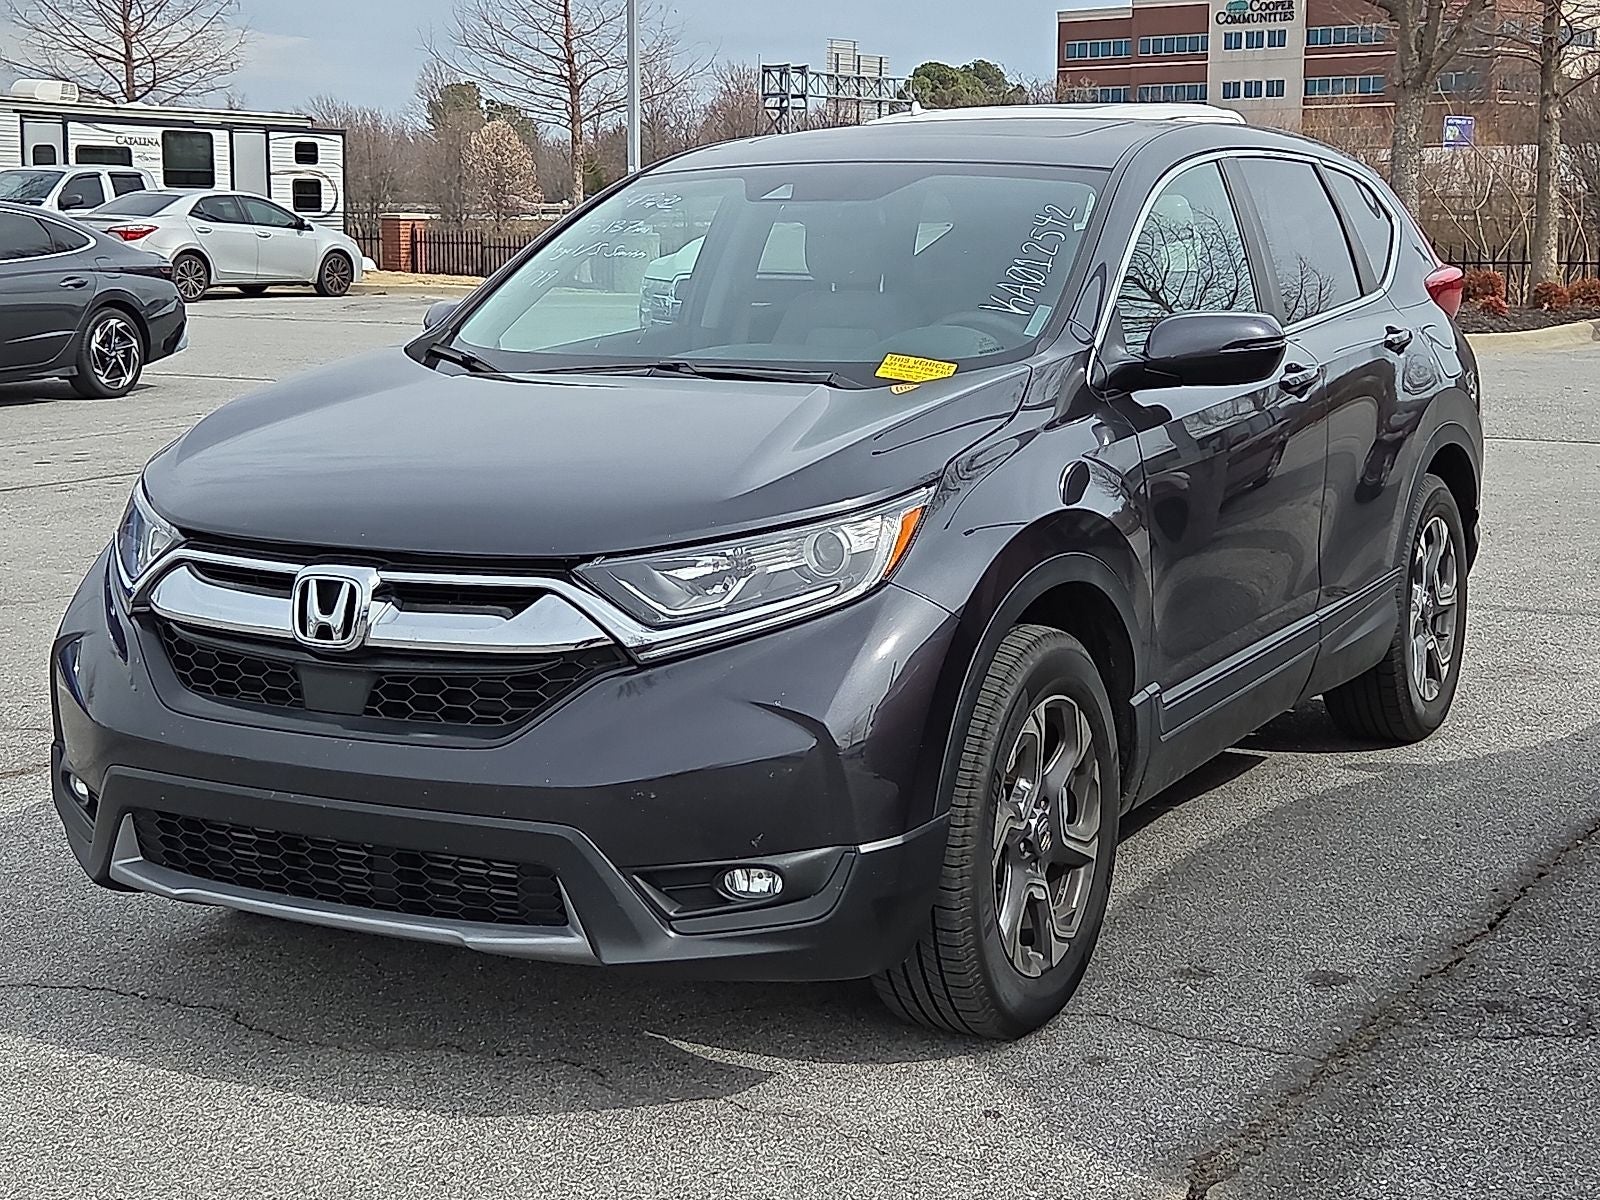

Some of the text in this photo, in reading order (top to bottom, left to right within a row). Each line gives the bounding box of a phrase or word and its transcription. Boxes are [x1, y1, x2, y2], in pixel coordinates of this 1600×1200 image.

[1249, 0, 1295, 12] COOPER
[1215, 11, 1295, 25] COMMUNITIES
[115, 135, 161, 147] CATALINA
[913, 359, 954, 371] VEHICLE
